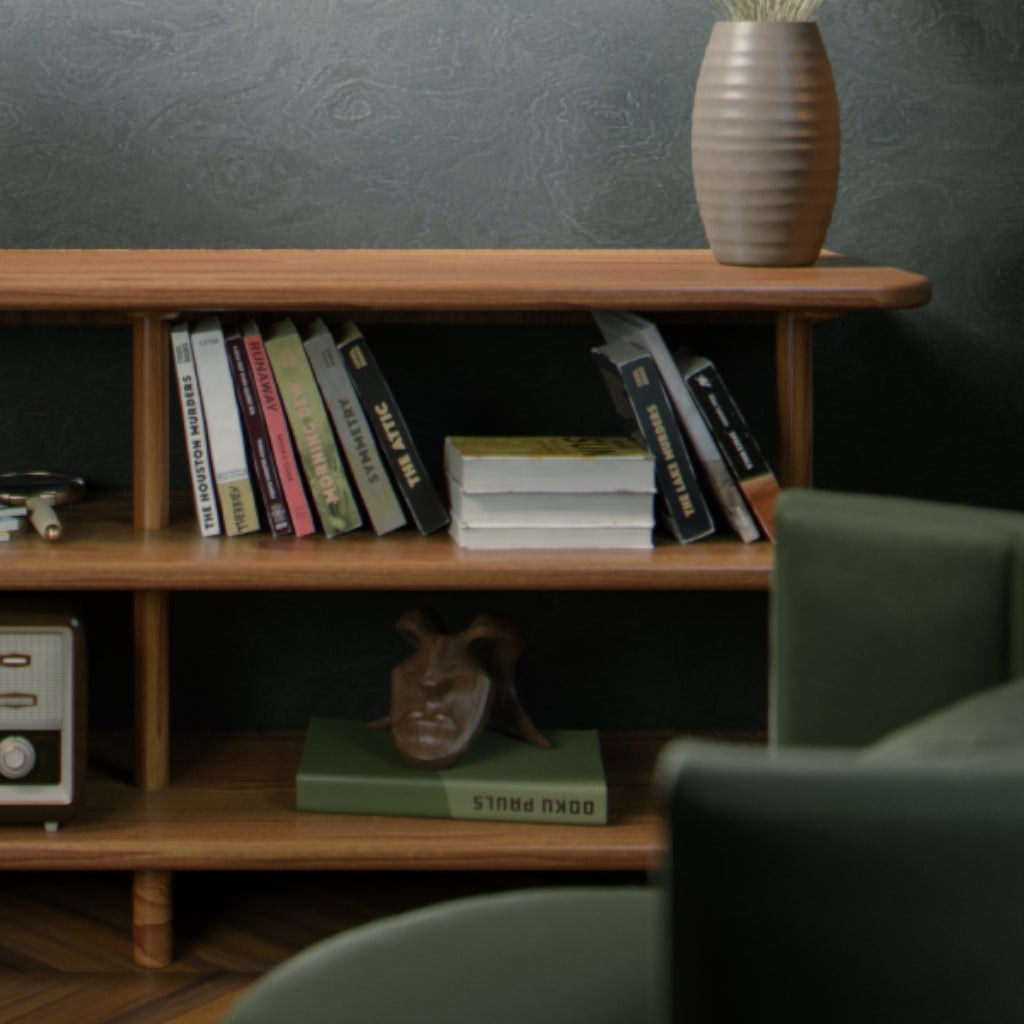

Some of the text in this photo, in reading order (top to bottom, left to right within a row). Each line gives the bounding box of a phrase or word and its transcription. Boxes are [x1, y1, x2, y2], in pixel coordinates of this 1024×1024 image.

[249, 341, 278, 412] RUNAWAY
[182, 374, 215, 530] THE HOUSTON MURDERS
[302, 422, 339, 504] MORNING
[338, 398, 380, 484] SYMMETRY
[374, 400, 421, 489] THE ATTIC
[646, 404, 675, 461] MURDERS
[678, 493, 695, 519] THE
[473, 794, 534, 813] PAULS
